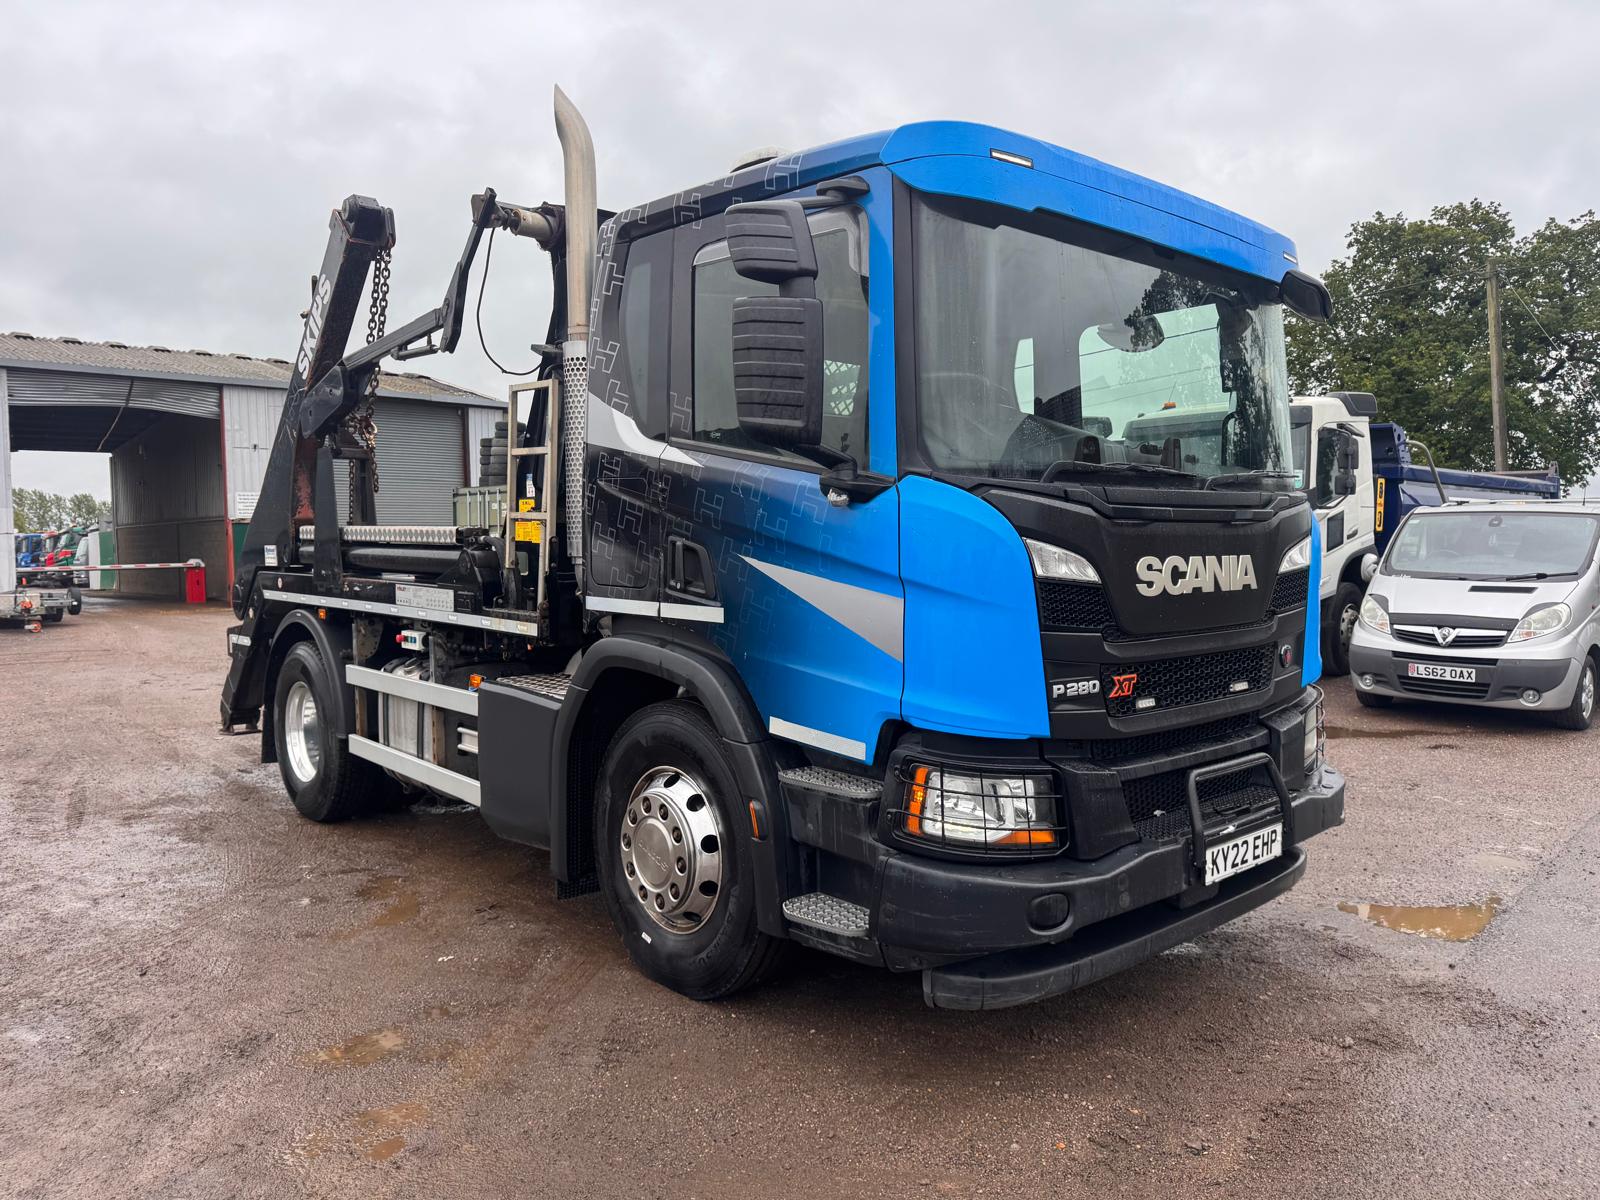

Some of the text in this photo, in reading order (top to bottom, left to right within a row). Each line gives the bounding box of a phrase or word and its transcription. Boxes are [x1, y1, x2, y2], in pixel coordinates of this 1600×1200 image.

[297, 273, 331, 380] SKIPS
[1136, 555, 1257, 597] SCANIA
[1109, 673, 1137, 698] XT
[1417, 666, 1474, 680] LS62 OAX
[1211, 829, 1278, 877] KY22 EHP
